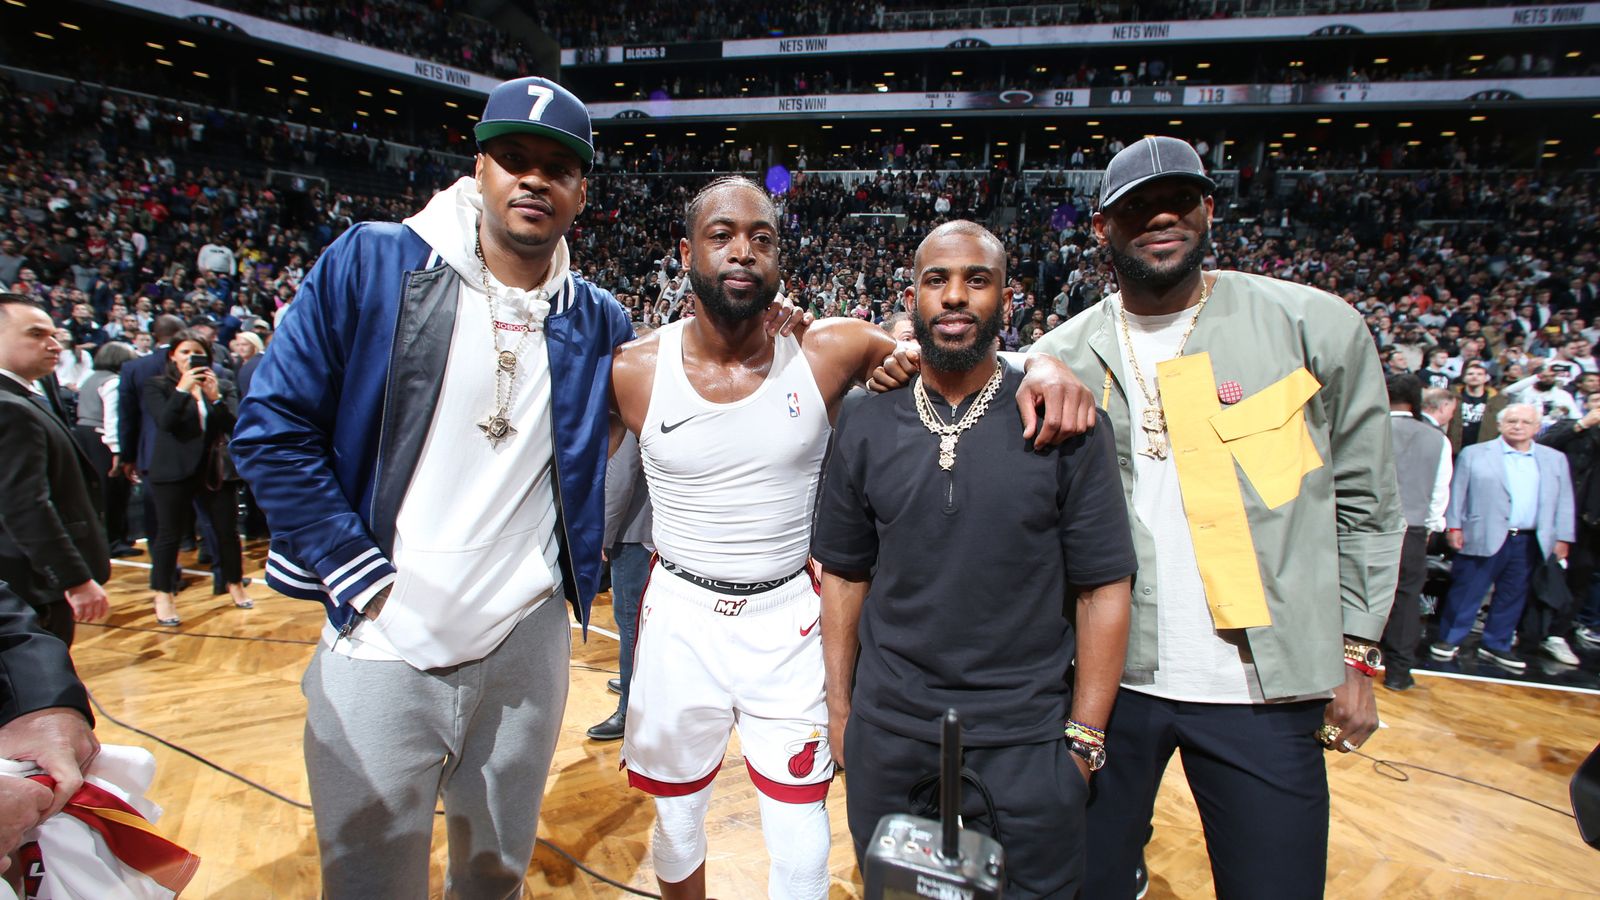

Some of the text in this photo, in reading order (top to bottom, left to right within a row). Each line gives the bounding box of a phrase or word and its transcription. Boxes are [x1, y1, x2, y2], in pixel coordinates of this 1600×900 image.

[1512, 6, 1585, 24] NETS WIN!
[1112, 25, 1170, 39] NETS WIN!
[779, 39, 828, 52] NETS WIN!
[625, 47, 660, 60] BLOCKS:
[414, 61, 471, 88] NETS WIN!
[527, 84, 555, 122] 7
[1054, 91, 1074, 106] 94
[1153, 91, 1172, 103] 4th
[1199, 89, 1224, 104] 113
[778, 97, 827, 111] NETS WIN!
